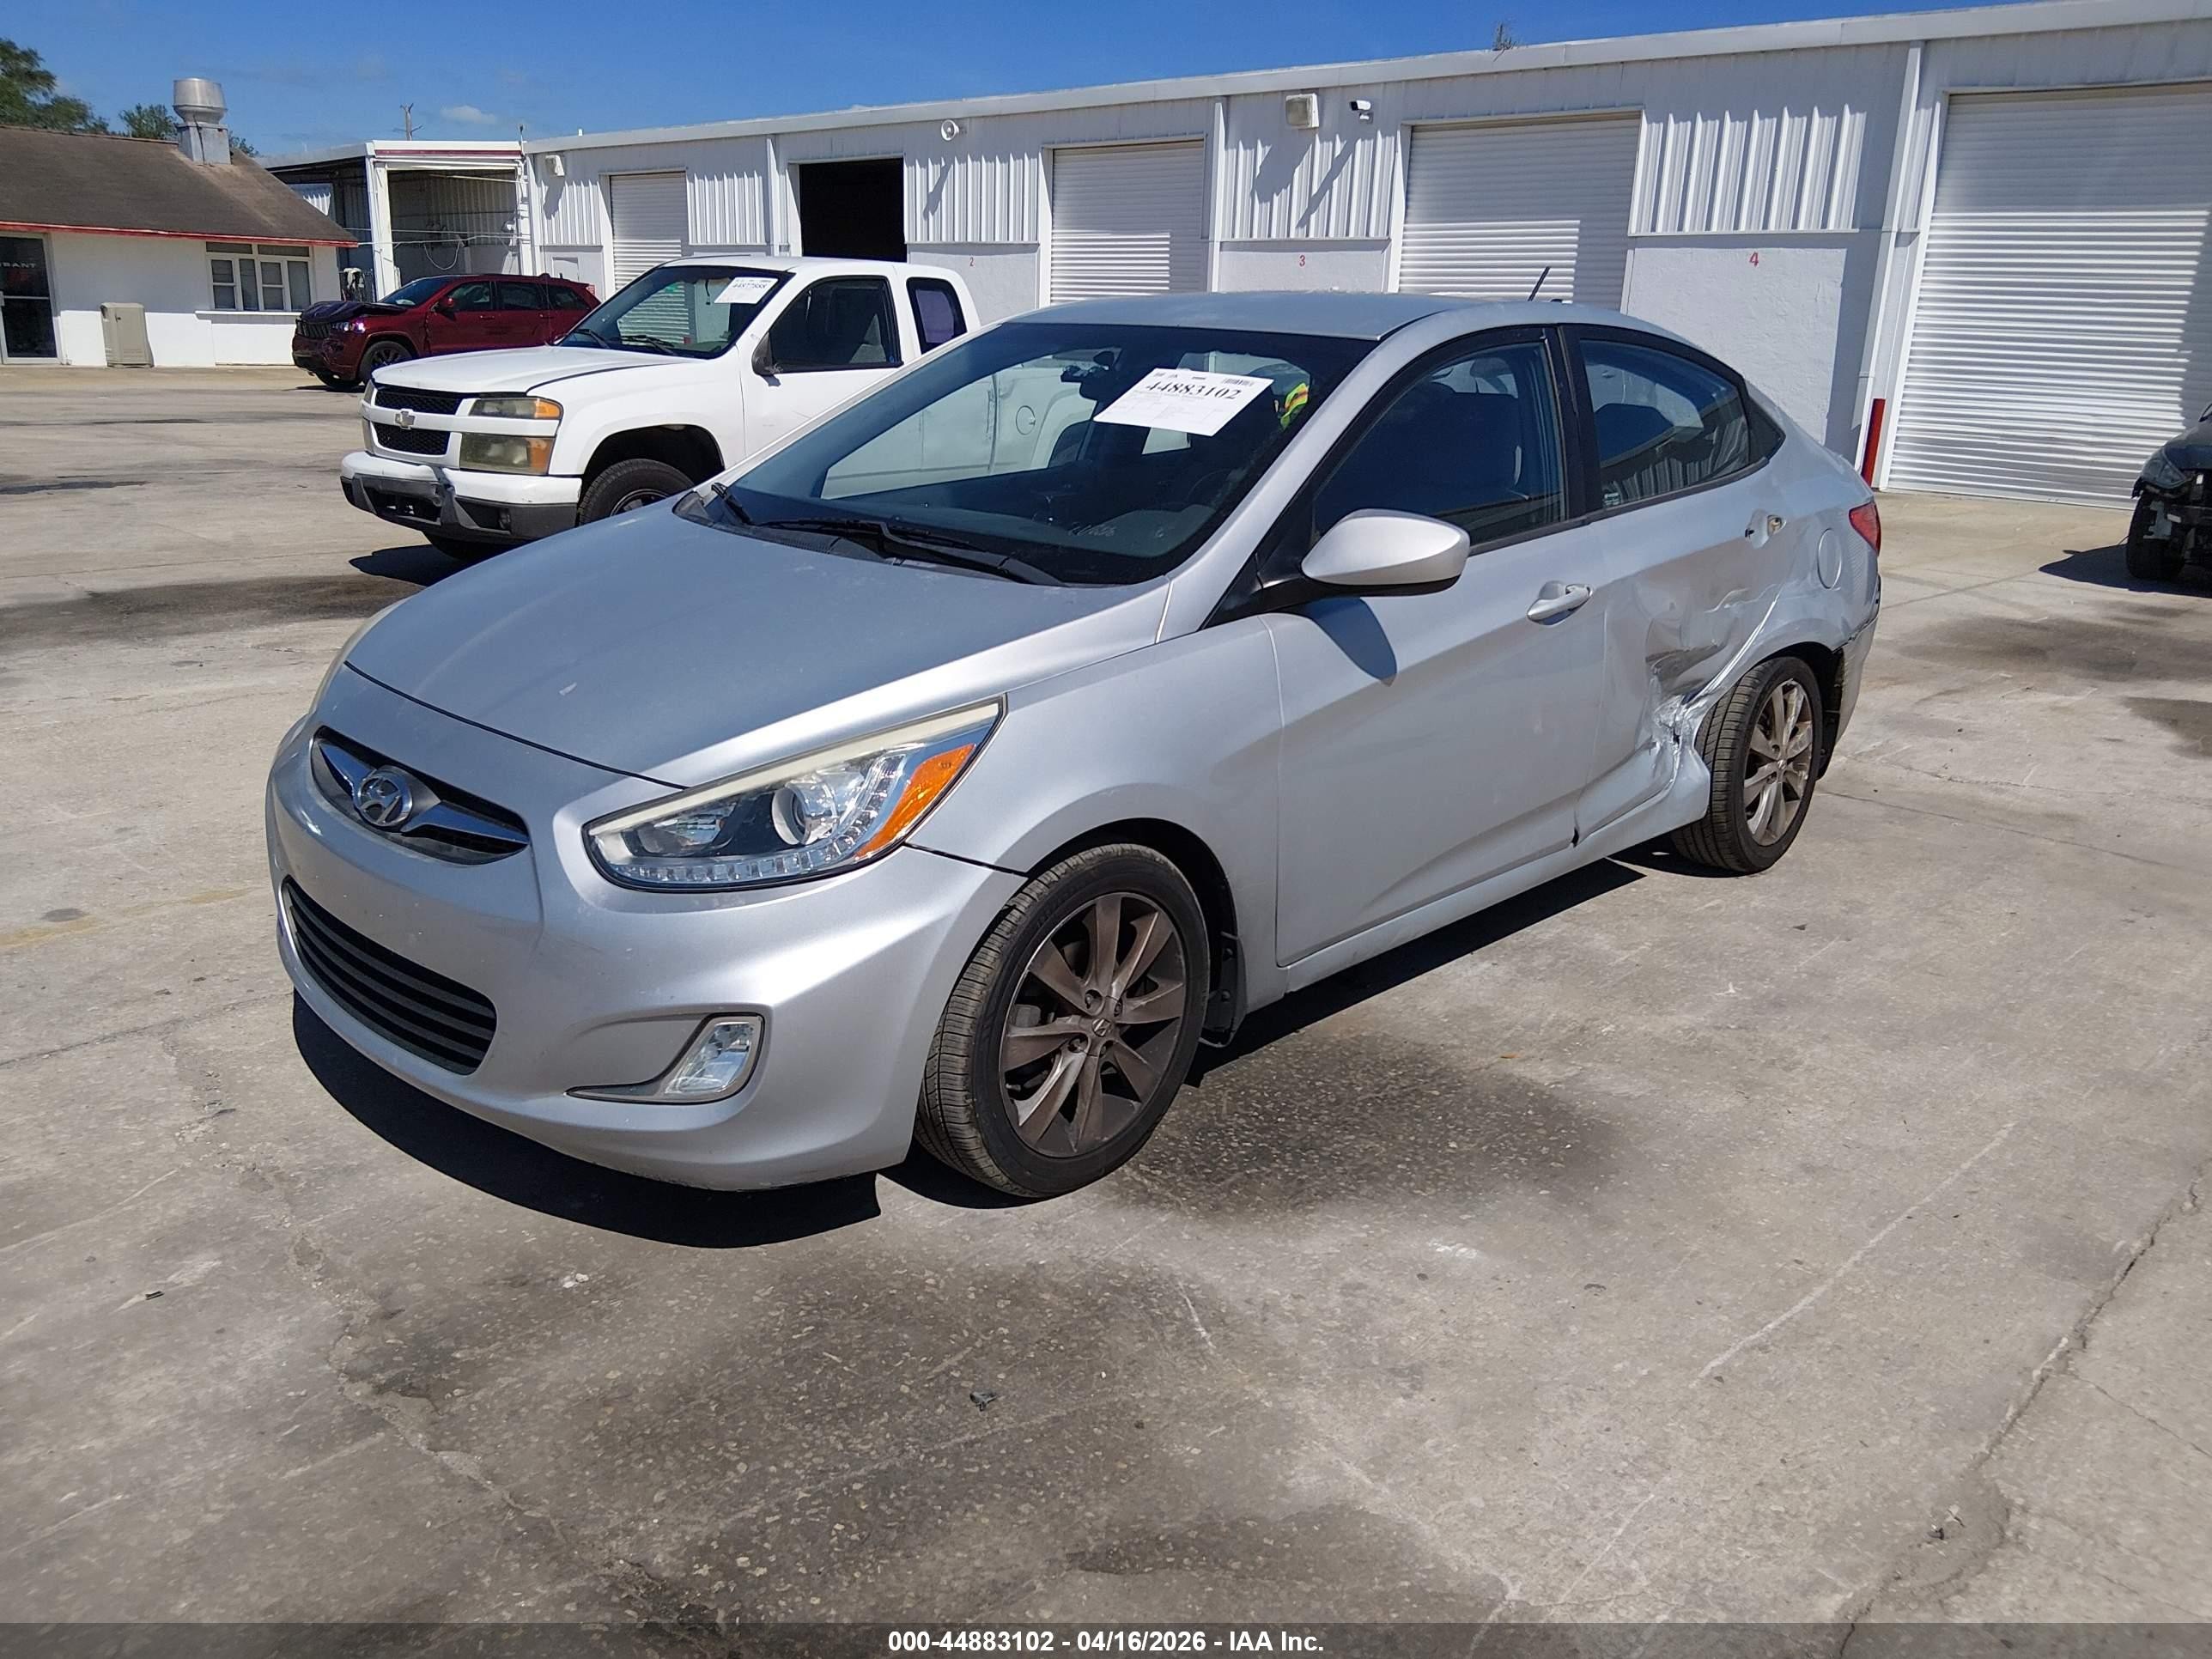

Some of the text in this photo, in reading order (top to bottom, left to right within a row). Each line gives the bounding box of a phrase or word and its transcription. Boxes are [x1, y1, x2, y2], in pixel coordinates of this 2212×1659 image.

[969, 256, 974, 267] 2
[1299, 254, 1305, 267] 3
[1749, 252, 1759, 267] 4
[1145, 380, 1242, 399] 44883102
